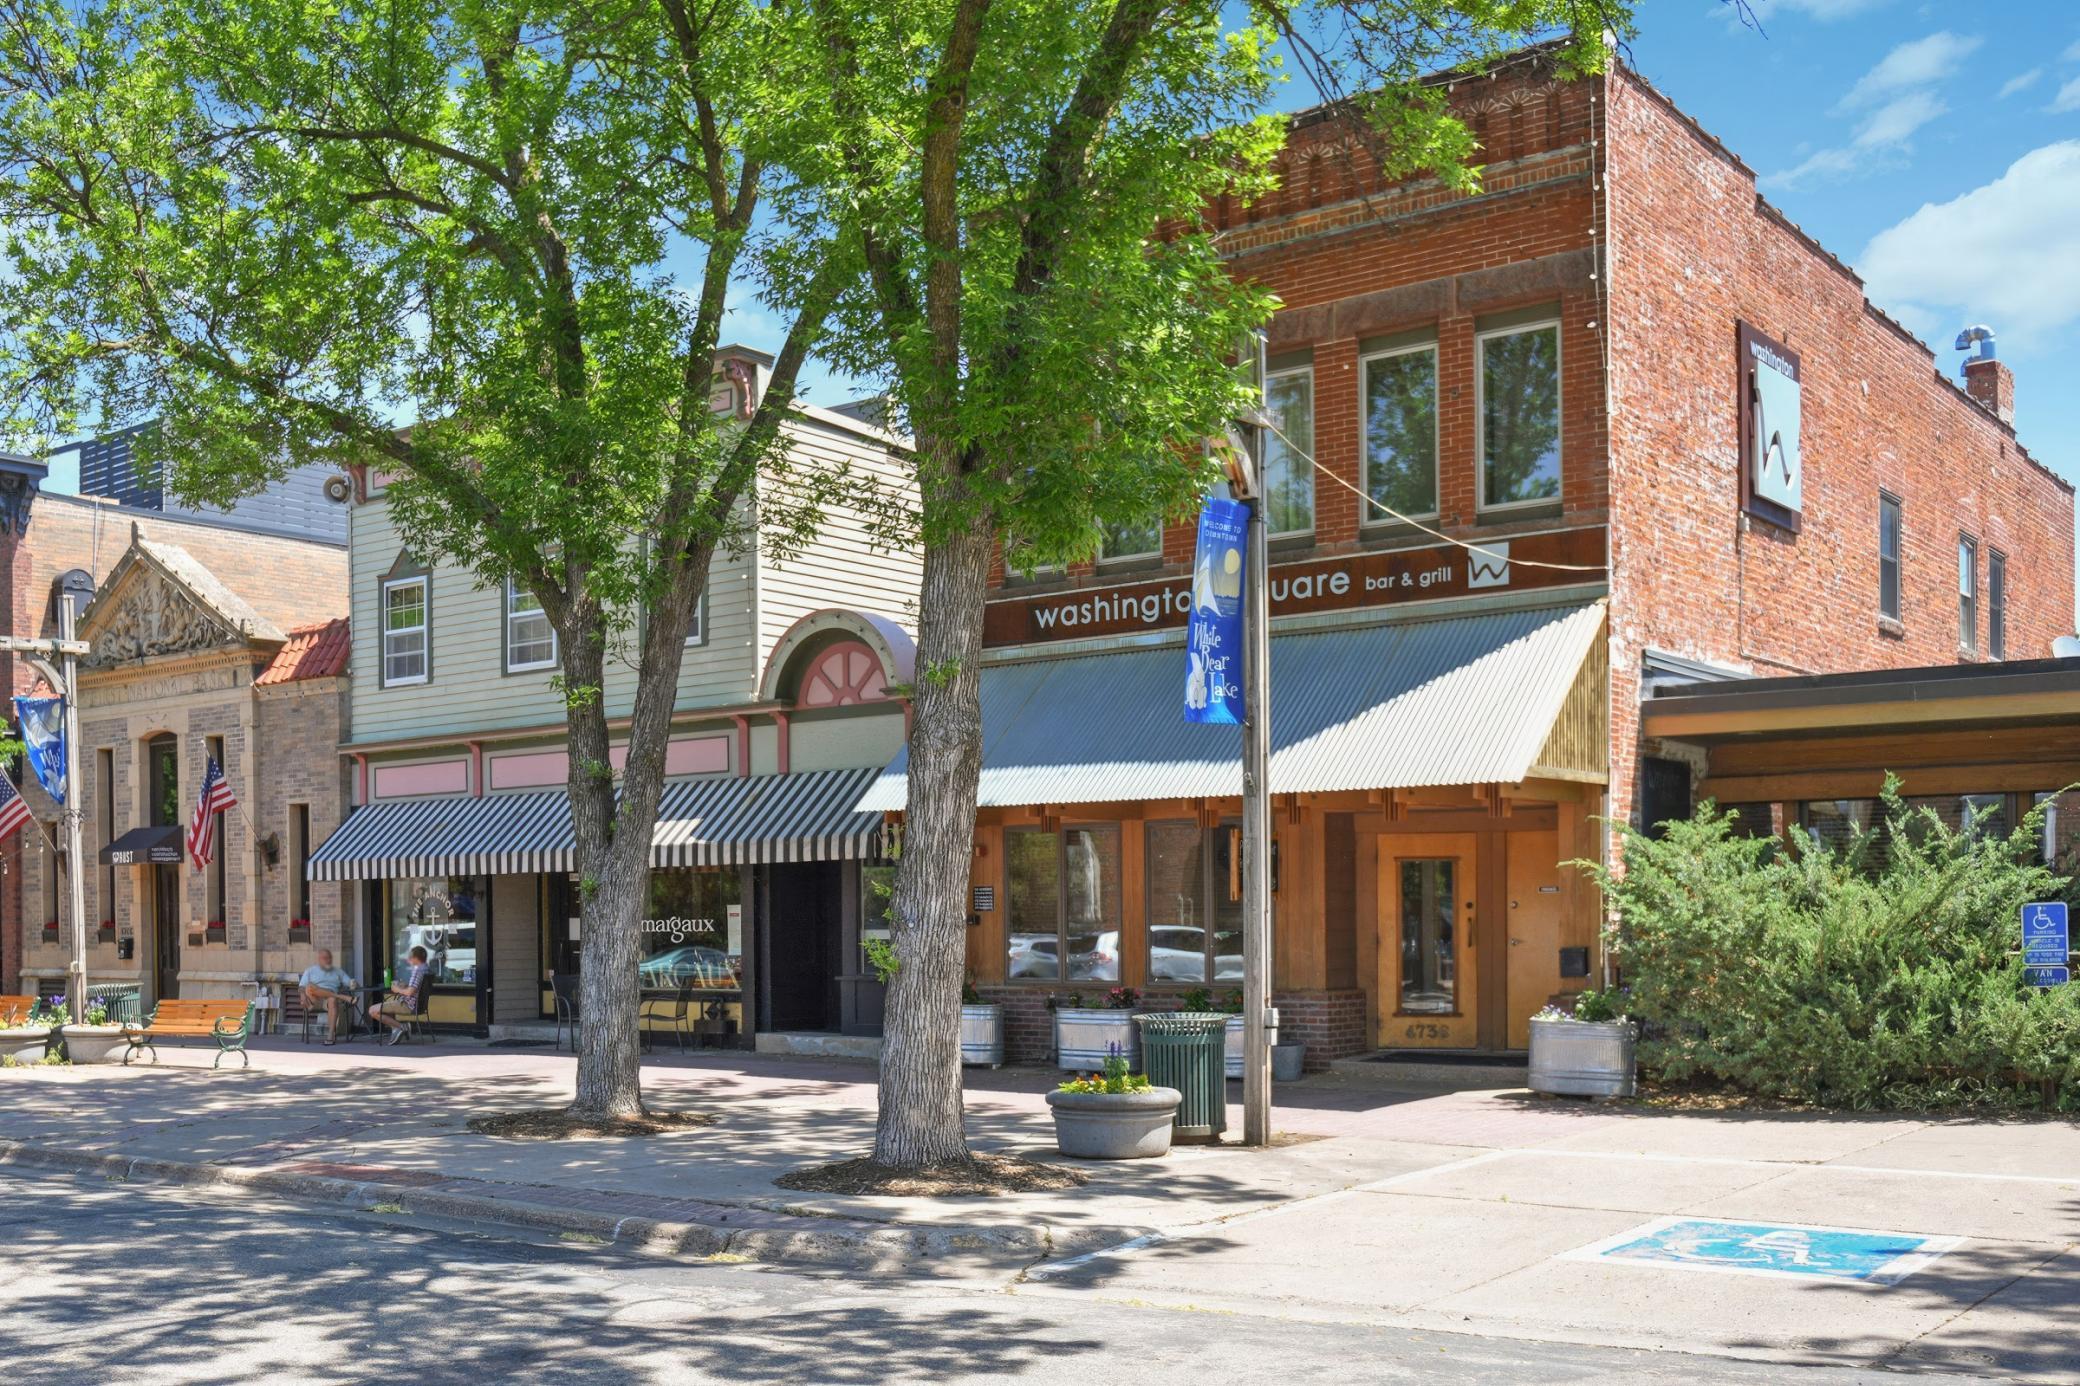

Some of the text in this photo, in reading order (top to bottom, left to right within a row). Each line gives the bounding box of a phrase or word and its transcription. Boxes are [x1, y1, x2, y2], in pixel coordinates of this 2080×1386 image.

[1750, 340, 1793, 379] washington
[1204, 520, 1241, 534] WELCOME TO
[1205, 529, 1237, 542] DOWNTOWN
[1034, 567, 1451, 629] washingto uare bar & grill
[1193, 620, 1222, 650] White
[1201, 644, 1230, 674] Bear
[1208, 671, 1239, 704] Lake
[412, 885, 455, 918] THE ANCHOR
[641, 916, 715, 943] margaux
[2034, 969, 2053, 977] VAN
